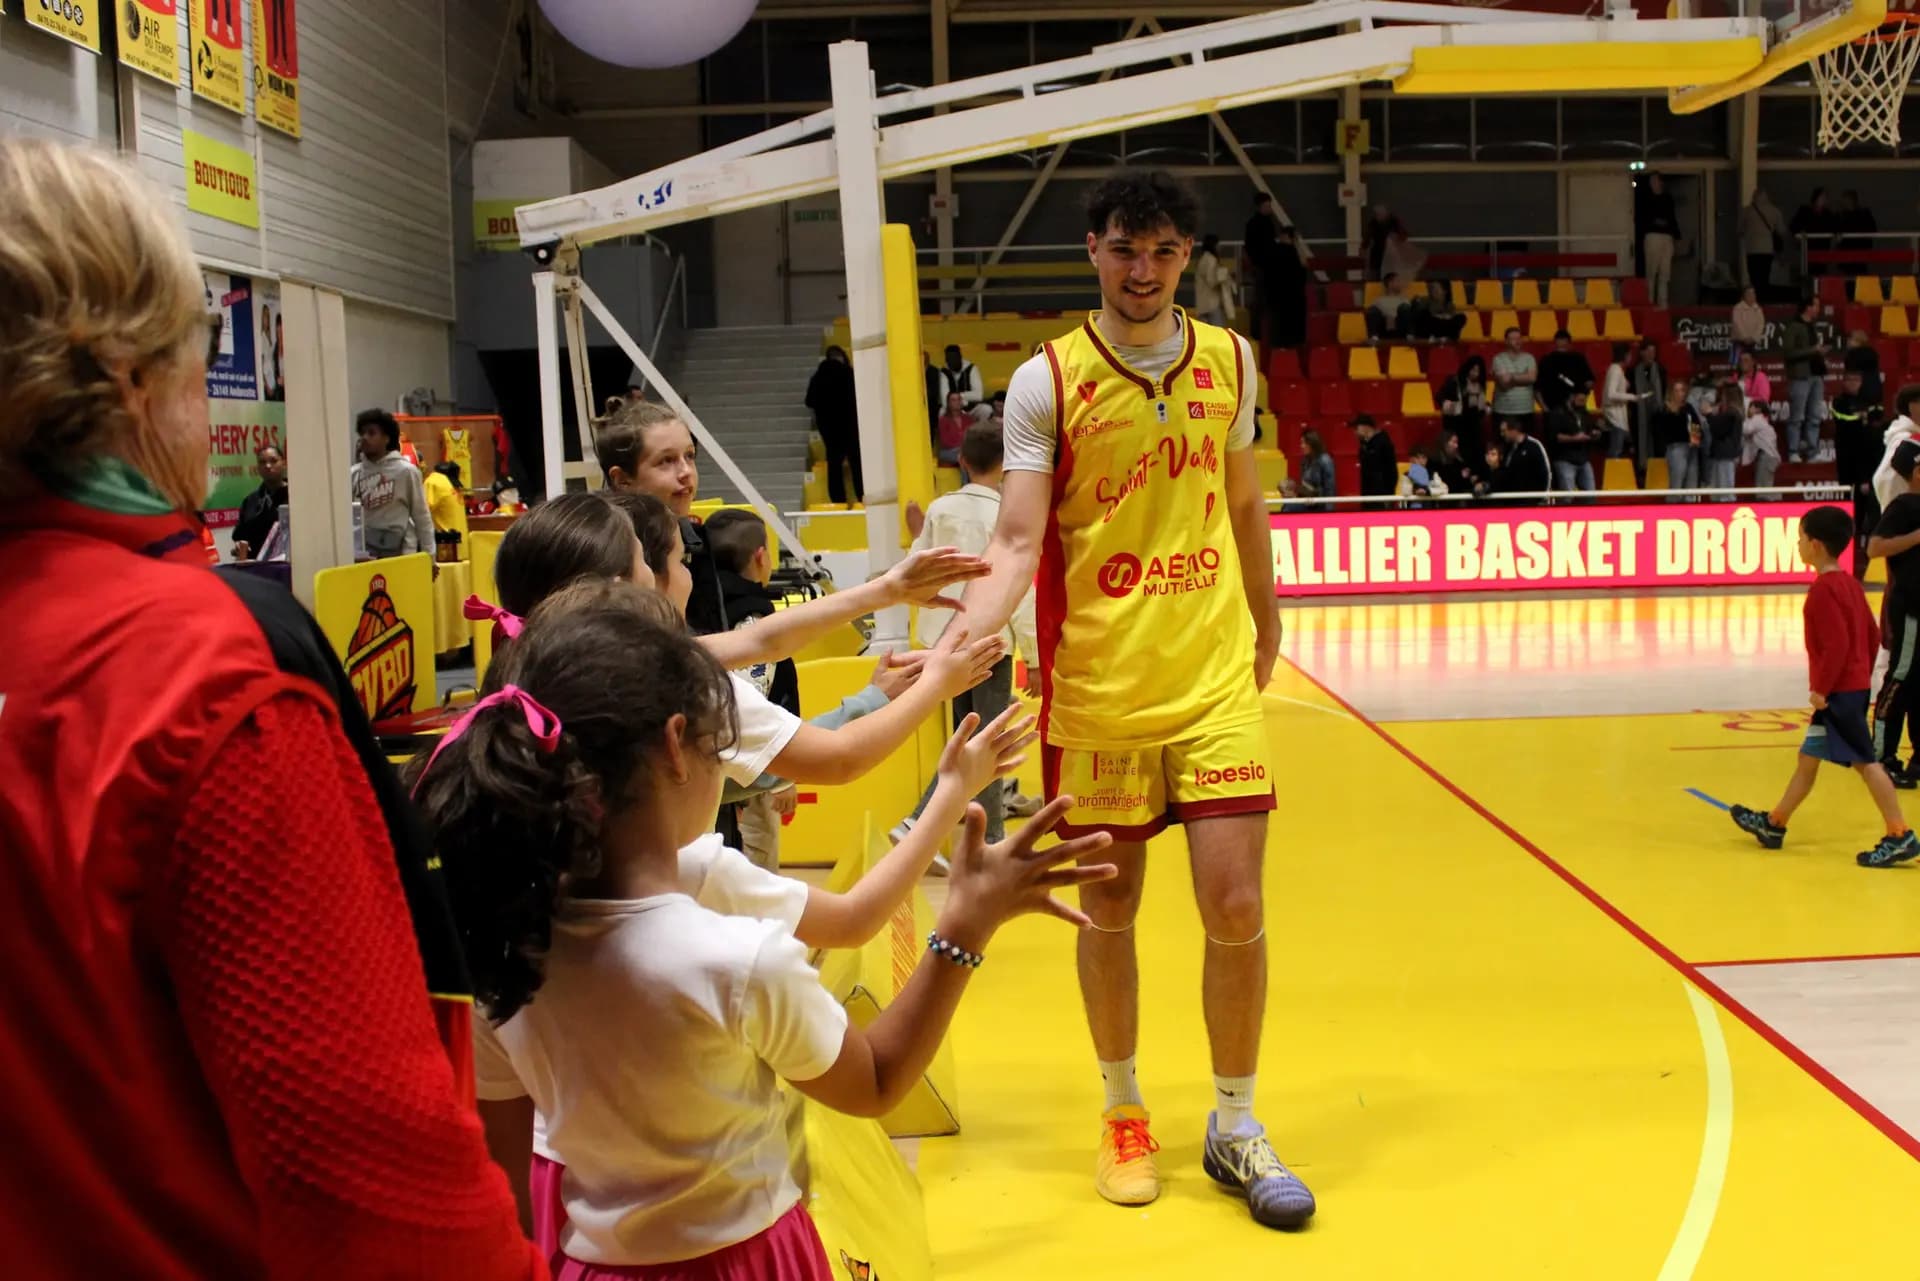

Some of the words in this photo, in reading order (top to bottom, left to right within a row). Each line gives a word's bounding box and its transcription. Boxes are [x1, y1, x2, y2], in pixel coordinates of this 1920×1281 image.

[144, 16, 160, 40] AIR
[154, 39, 174, 59] TEMPS
[1345, 124, 1360, 149] F
[194, 159, 251, 201] BOUTIQUE
[1445, 519, 1644, 580] BASKET
[1656, 506, 1816, 575] DRÔM
[1194, 760, 1265, 787] koesio
